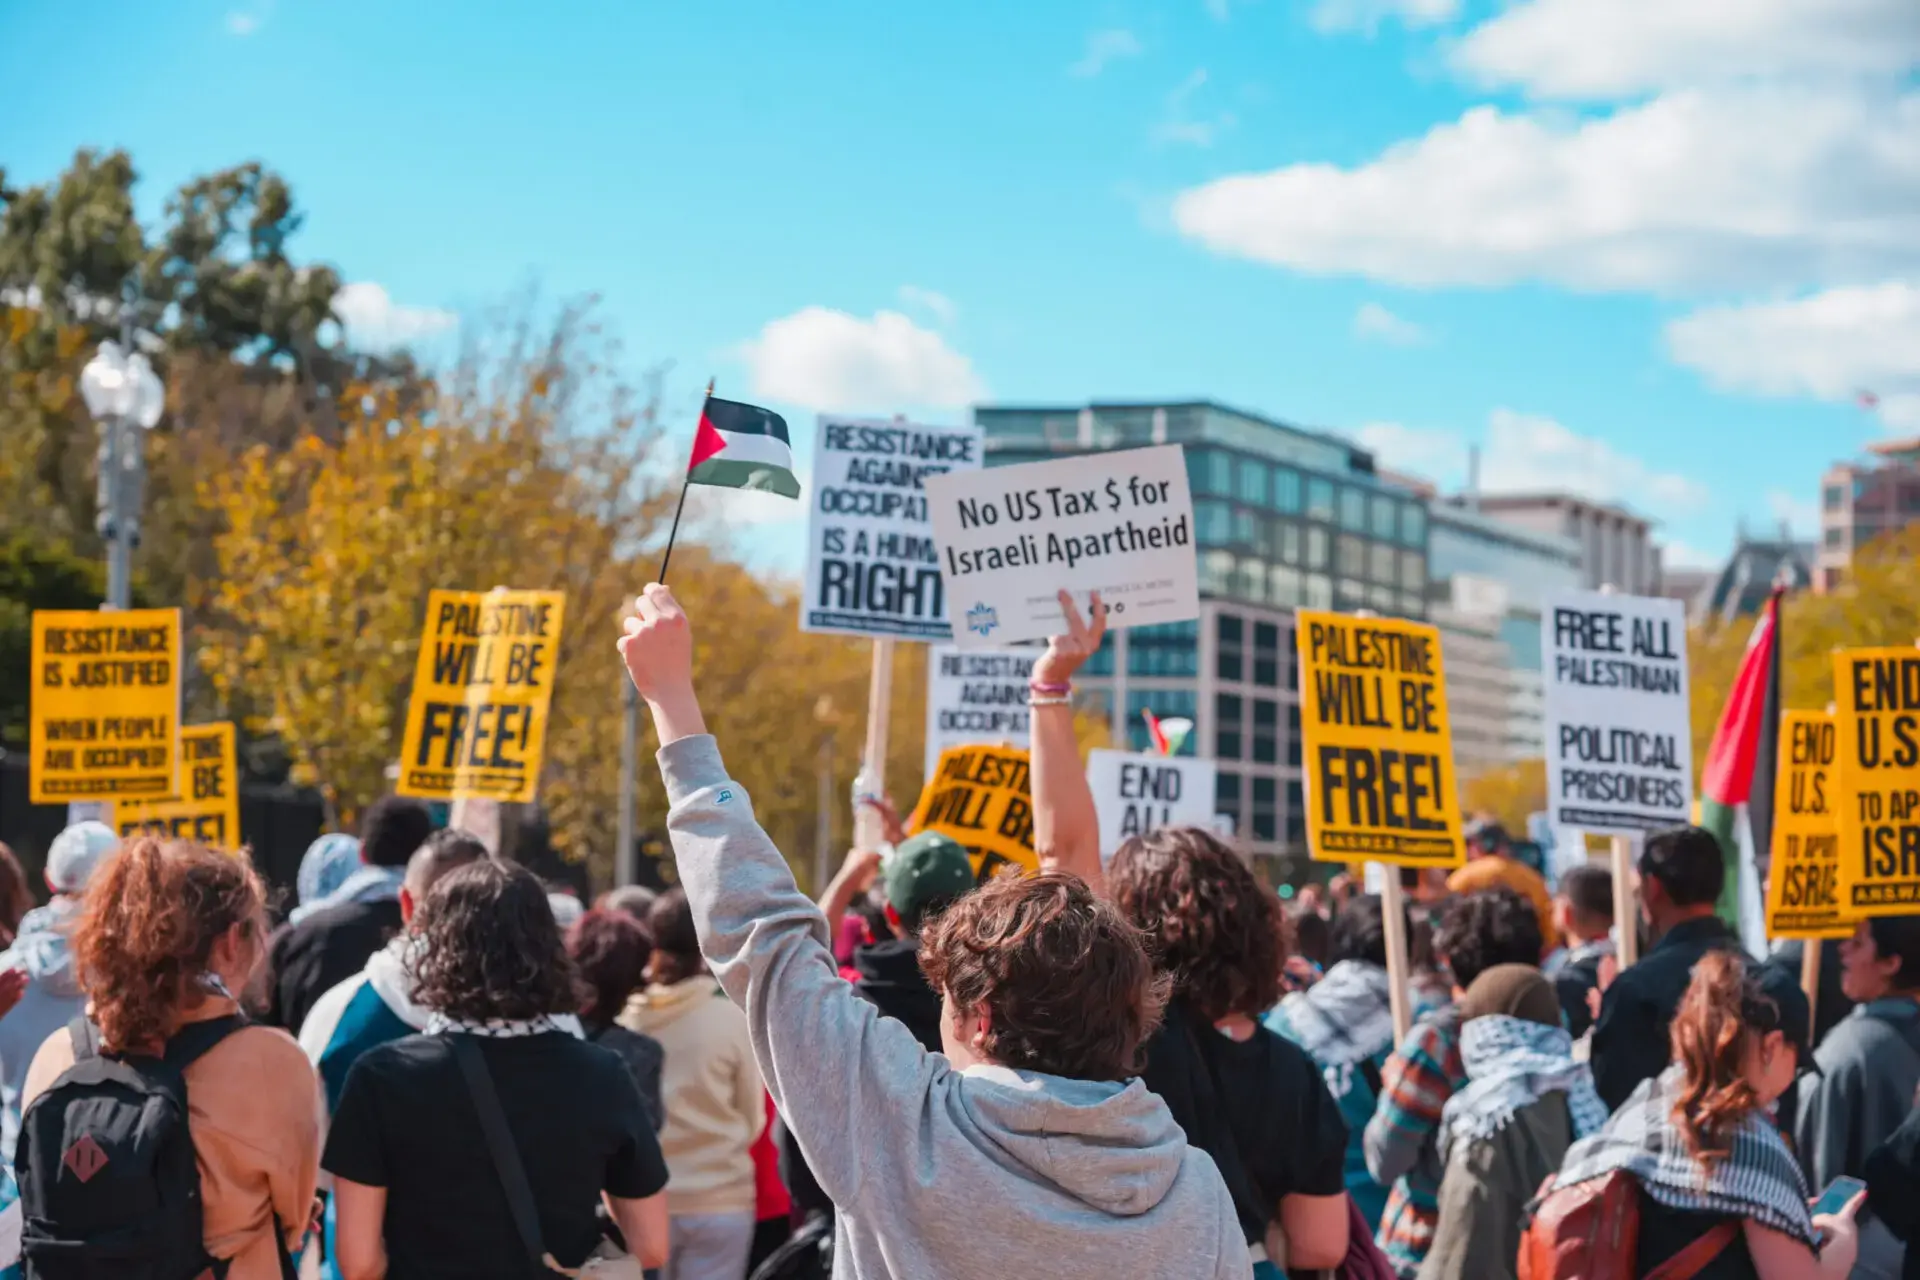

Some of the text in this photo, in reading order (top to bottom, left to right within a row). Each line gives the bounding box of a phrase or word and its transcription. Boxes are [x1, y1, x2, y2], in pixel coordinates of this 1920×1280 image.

[825, 425, 974, 462] RESISTANCE
[846, 457, 951, 490] AGAIN
[957, 475, 1171, 530] No US Tax $ for
[823, 527, 846, 555] IS
[853, 529, 869, 555] A
[946, 514, 1189, 576] Israeli Apartheid
[44, 625, 170, 655] RESISTANCE
[436, 602, 552, 637] PALESTINE
[1555, 608, 1680, 660] FREE ALL
[433, 641, 545, 686] WILL BE
[1309, 621, 1436, 677] PALESTINE
[43, 660, 170, 687] IS JUSTIFIED
[1556, 654, 1682, 695] PALESTINIAN
[1853, 657, 1920, 711] END
[1315, 668, 1440, 734] WILL BE
[44, 716, 167, 741] WHEN PEOPLE
[417, 702, 534, 769] FREE!
[1559, 722, 1682, 771] POLITICAL
[1792, 721, 1836, 766] END
[44, 748, 76, 771] ARE
[193, 763, 225, 799] BE
[1119, 763, 1181, 802] END
[1318, 744, 1449, 832] FREE!
[1561, 767, 1685, 809] PRISONERS
[924, 785, 991, 830] WILL
[1858, 791, 1882, 821] TO
